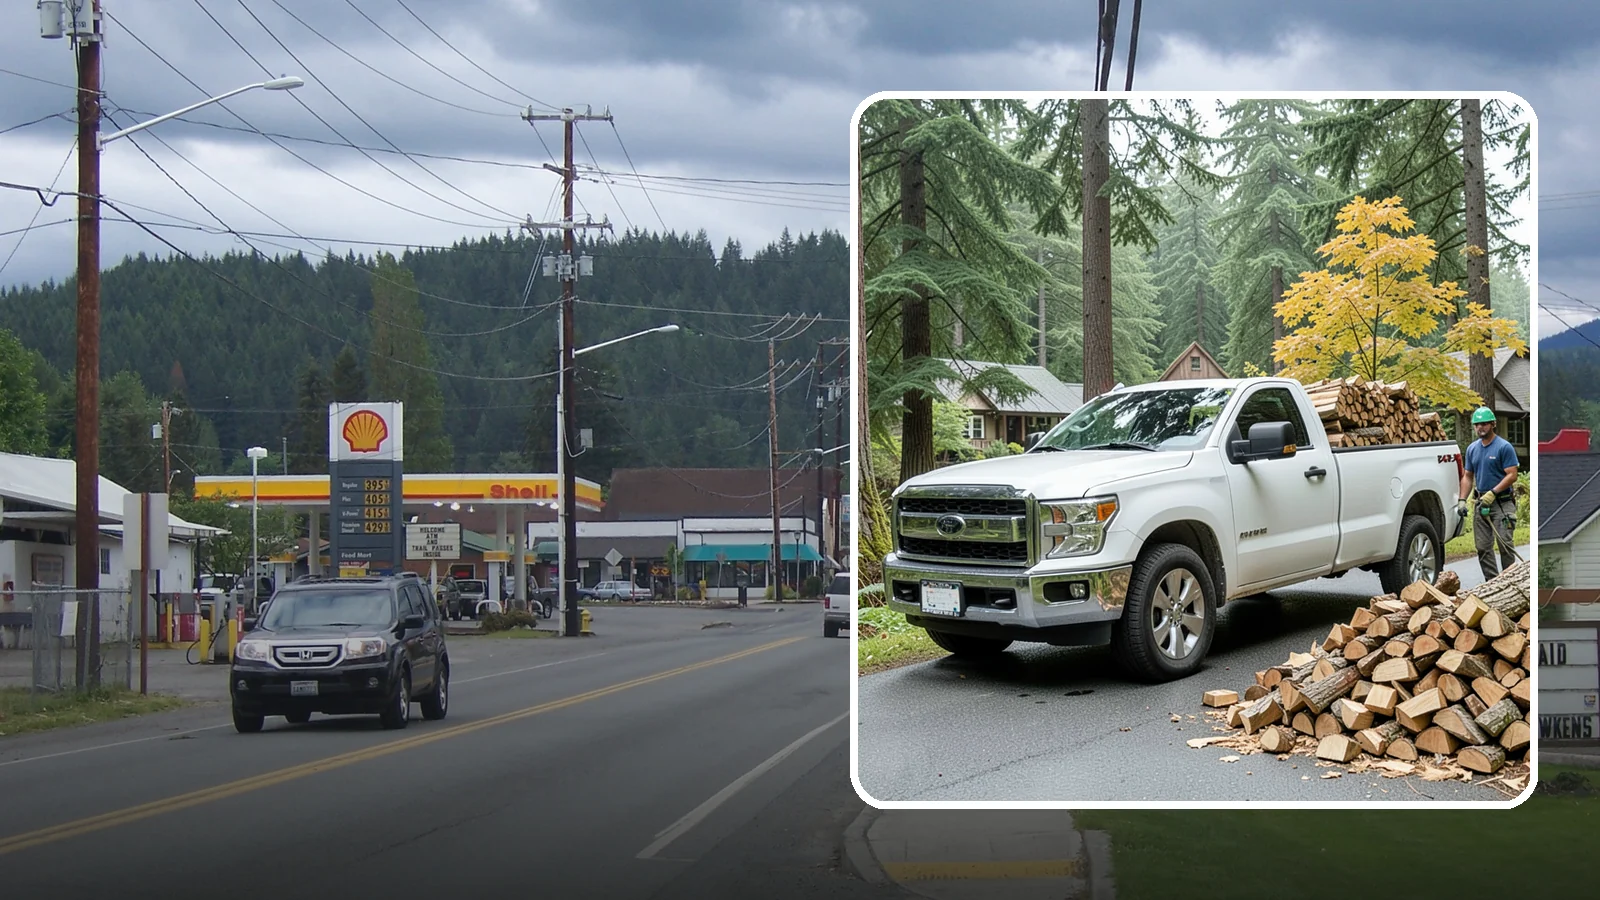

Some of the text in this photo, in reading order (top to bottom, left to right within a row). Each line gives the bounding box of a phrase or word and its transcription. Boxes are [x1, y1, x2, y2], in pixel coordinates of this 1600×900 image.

[365, 480, 384, 490] 395
[490, 484, 547, 499] Shell
[365, 494, 384, 504] 405
[365, 508, 383, 518] 415
[365, 522, 384, 532] 429
